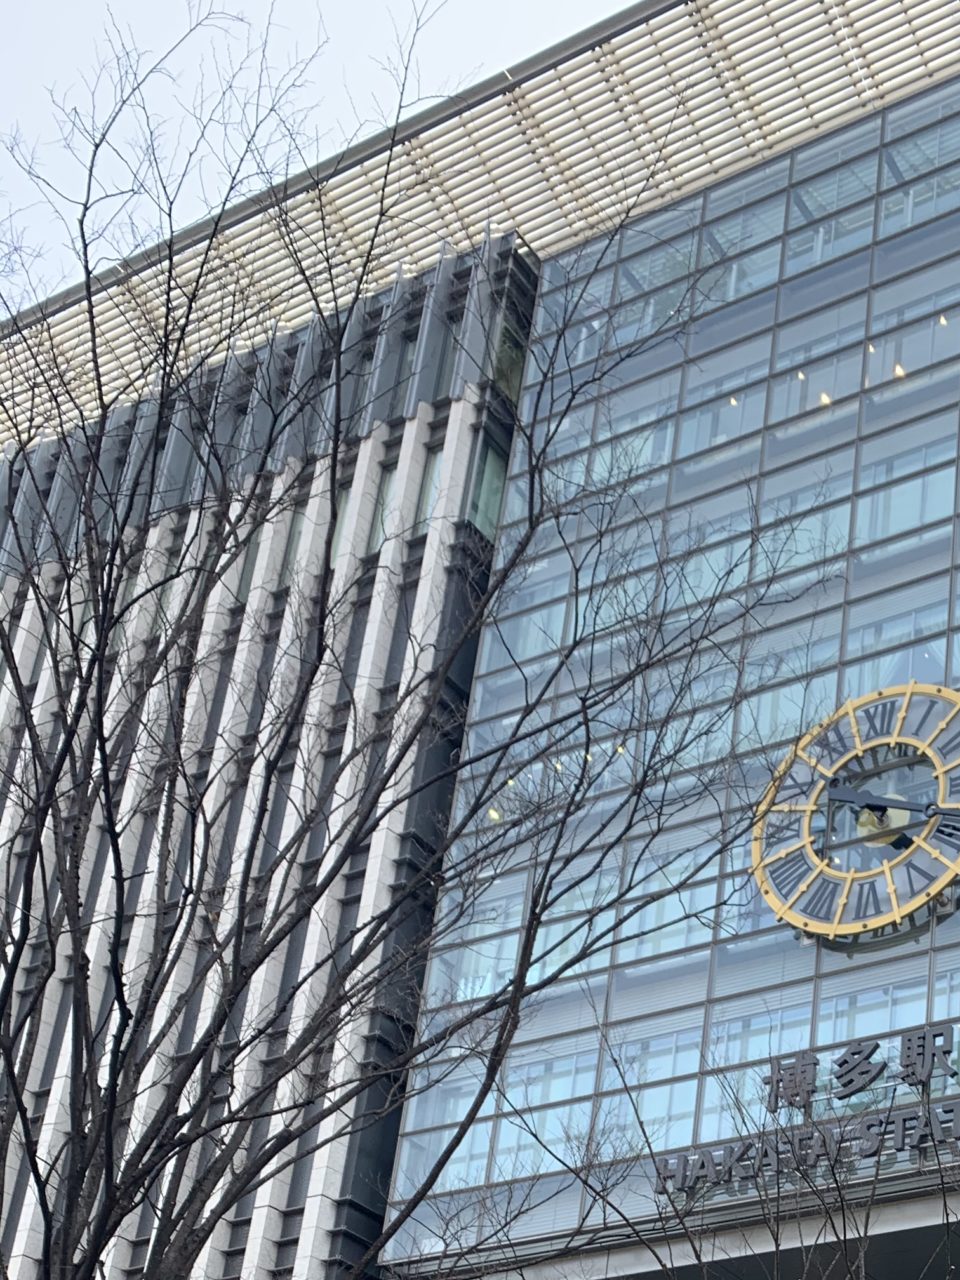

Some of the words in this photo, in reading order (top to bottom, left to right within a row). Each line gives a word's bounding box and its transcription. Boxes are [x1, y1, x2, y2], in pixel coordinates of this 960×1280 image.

[762, 1024, 960, 1114] 博多駅
[655, 1126, 838, 1196] HAKATA
